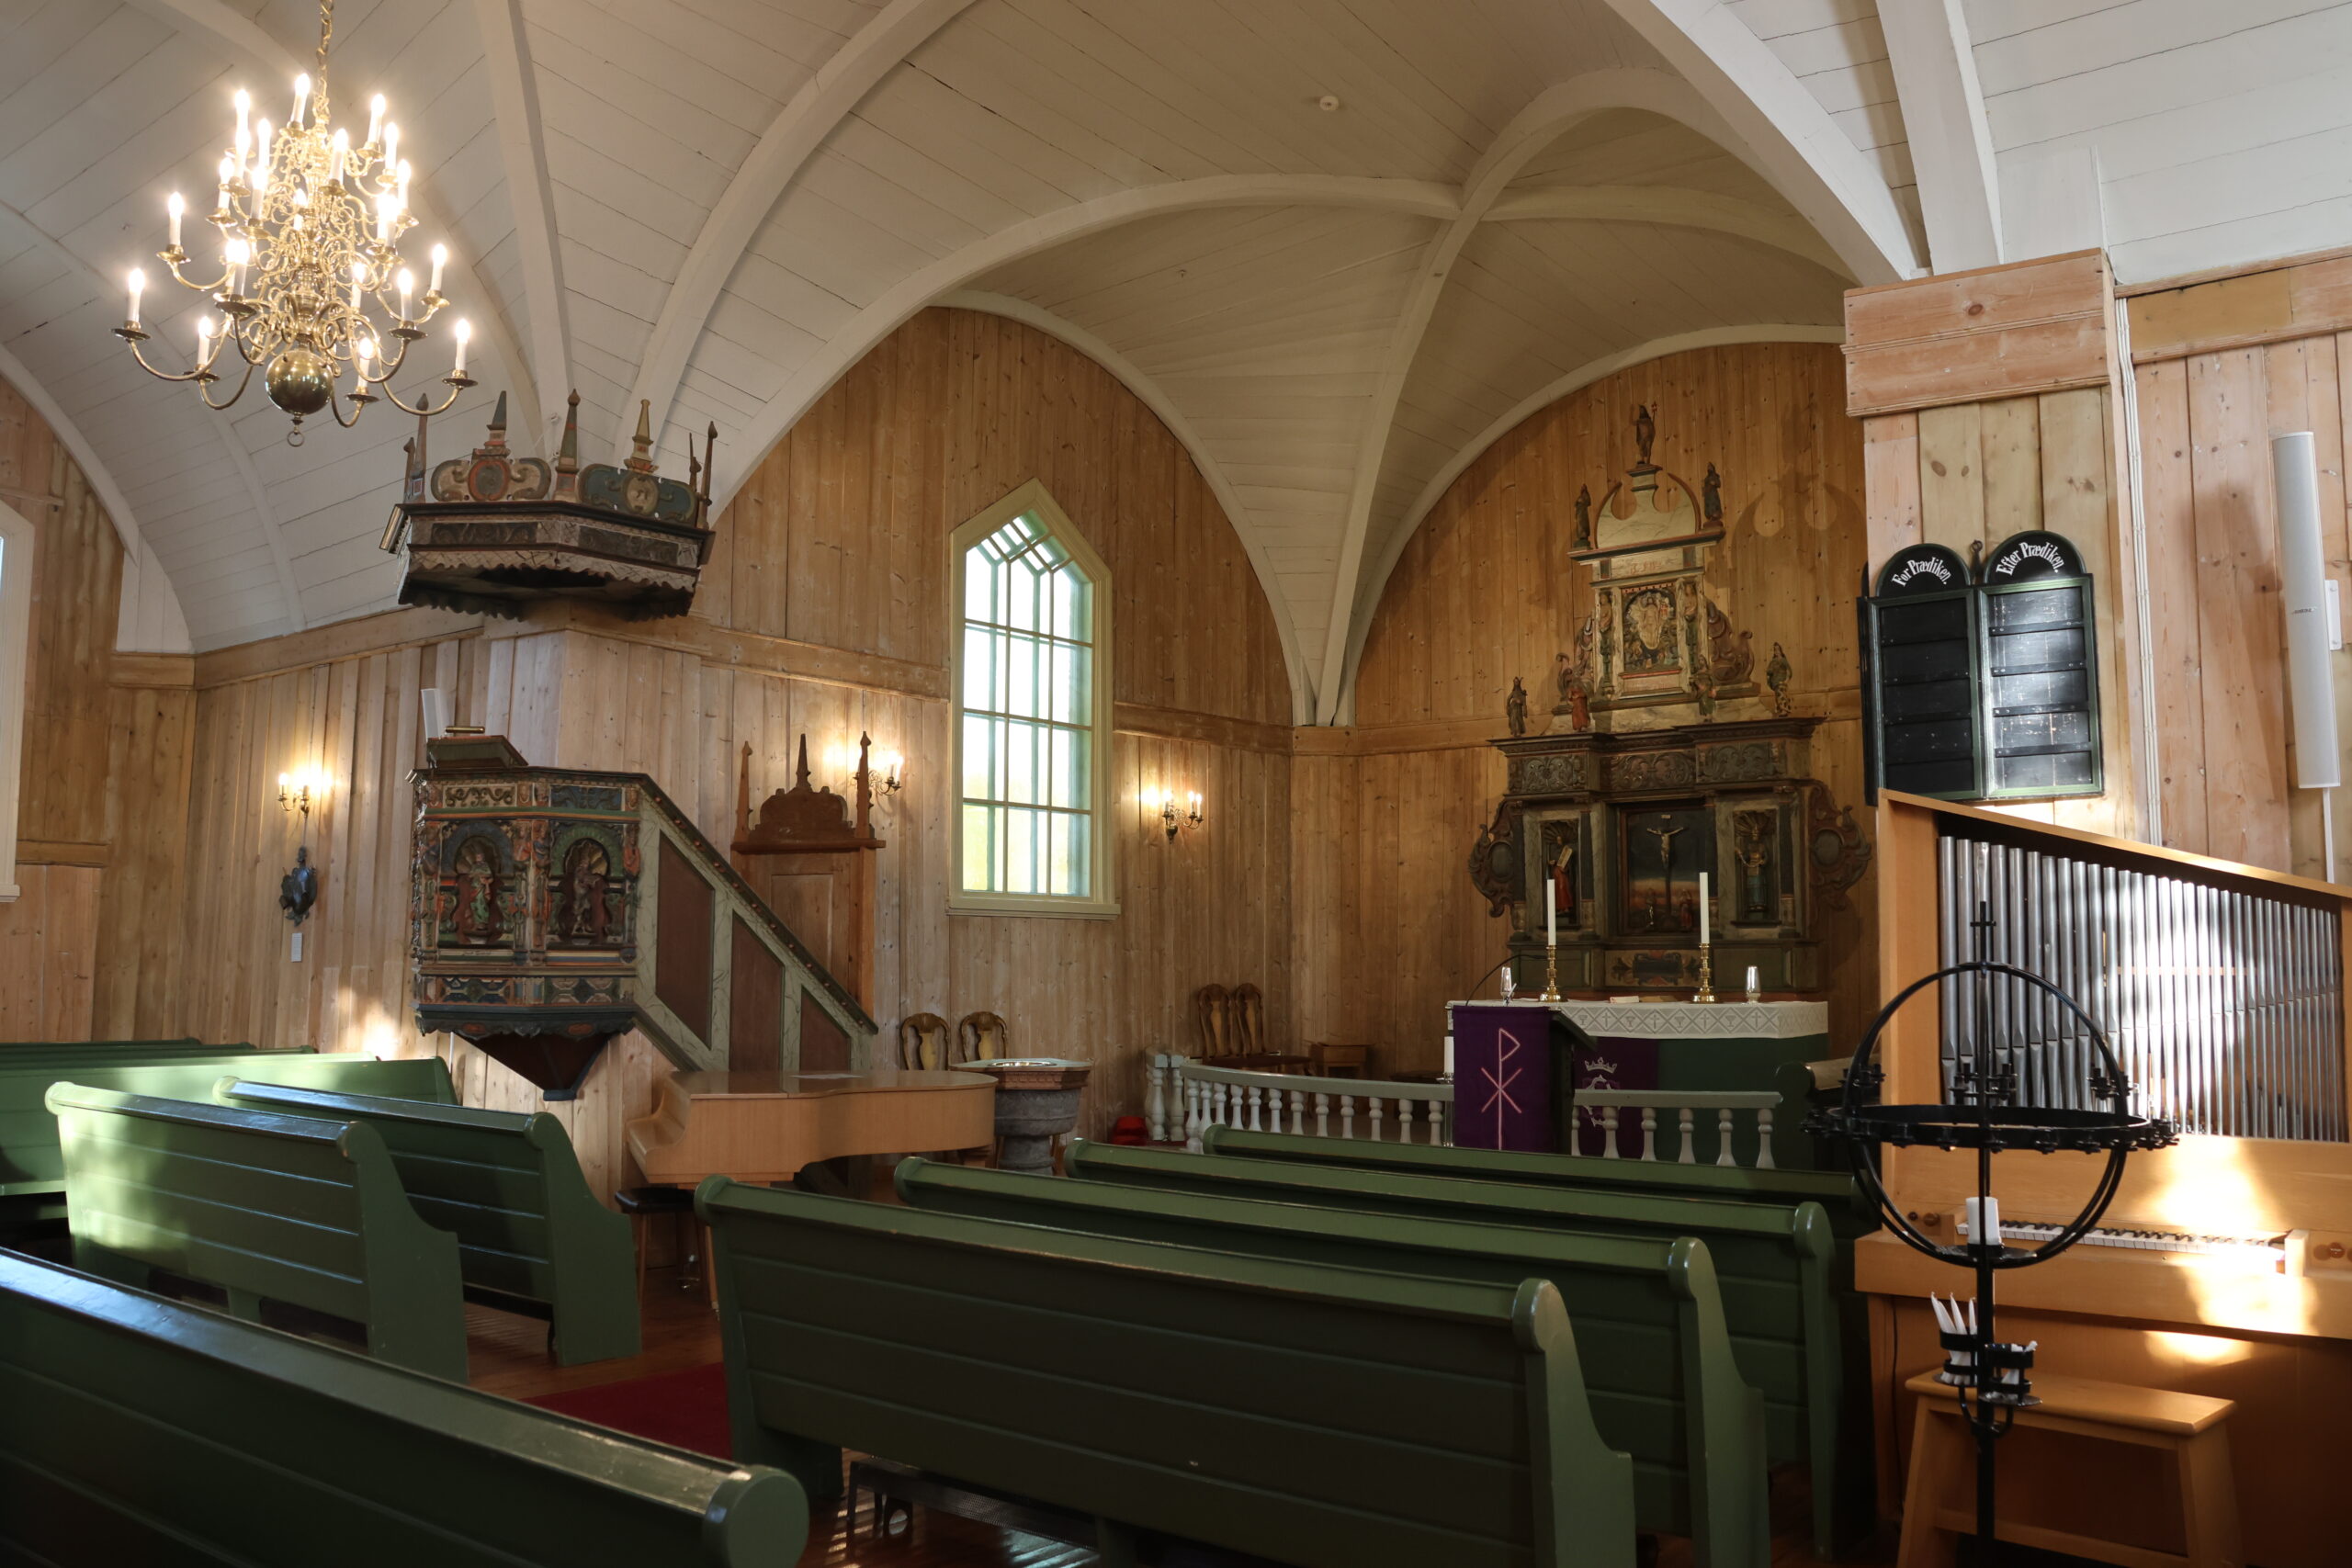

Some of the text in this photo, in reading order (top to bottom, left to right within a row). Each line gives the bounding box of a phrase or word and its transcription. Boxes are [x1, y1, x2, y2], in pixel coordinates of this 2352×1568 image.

[1891, 557, 1951, 587] For Prædiken.
[1996, 541, 2064, 576] Efter Prædiken.
